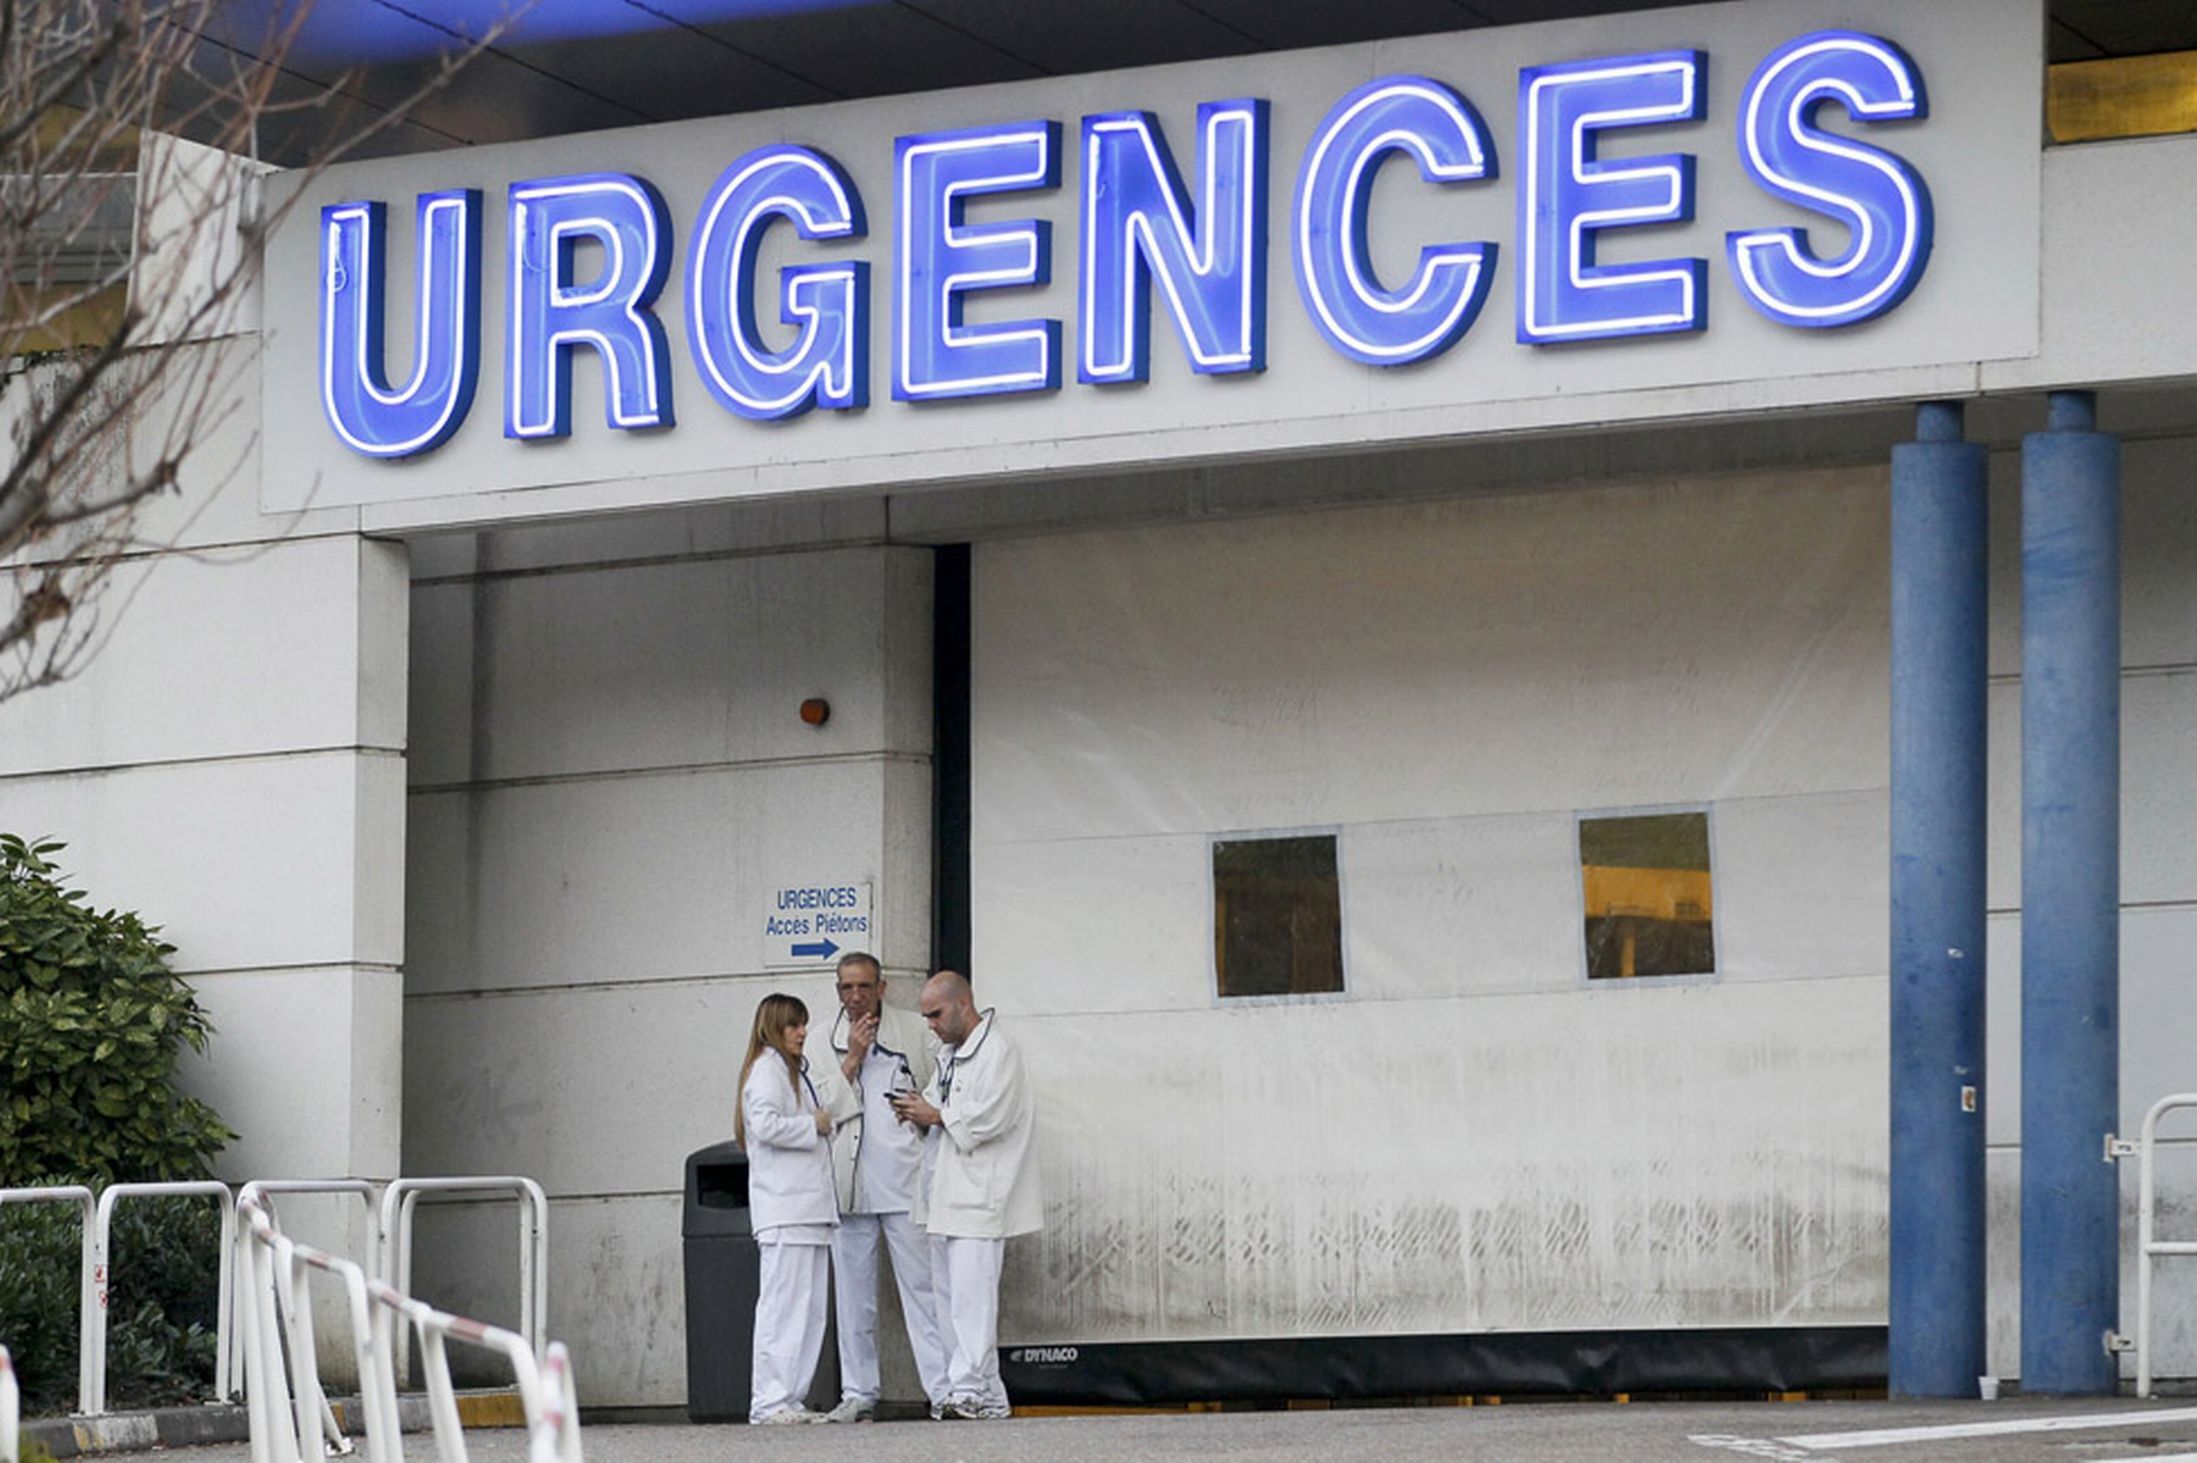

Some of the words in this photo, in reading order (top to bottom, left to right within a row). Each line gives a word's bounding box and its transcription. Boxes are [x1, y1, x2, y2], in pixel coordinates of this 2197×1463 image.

[321, 31, 1935, 460] URGENCES
[777, 886, 857, 910] URGENCES
[815, 912, 867, 933] Piétons
[1024, 1347, 1079, 1362] DYNACO
